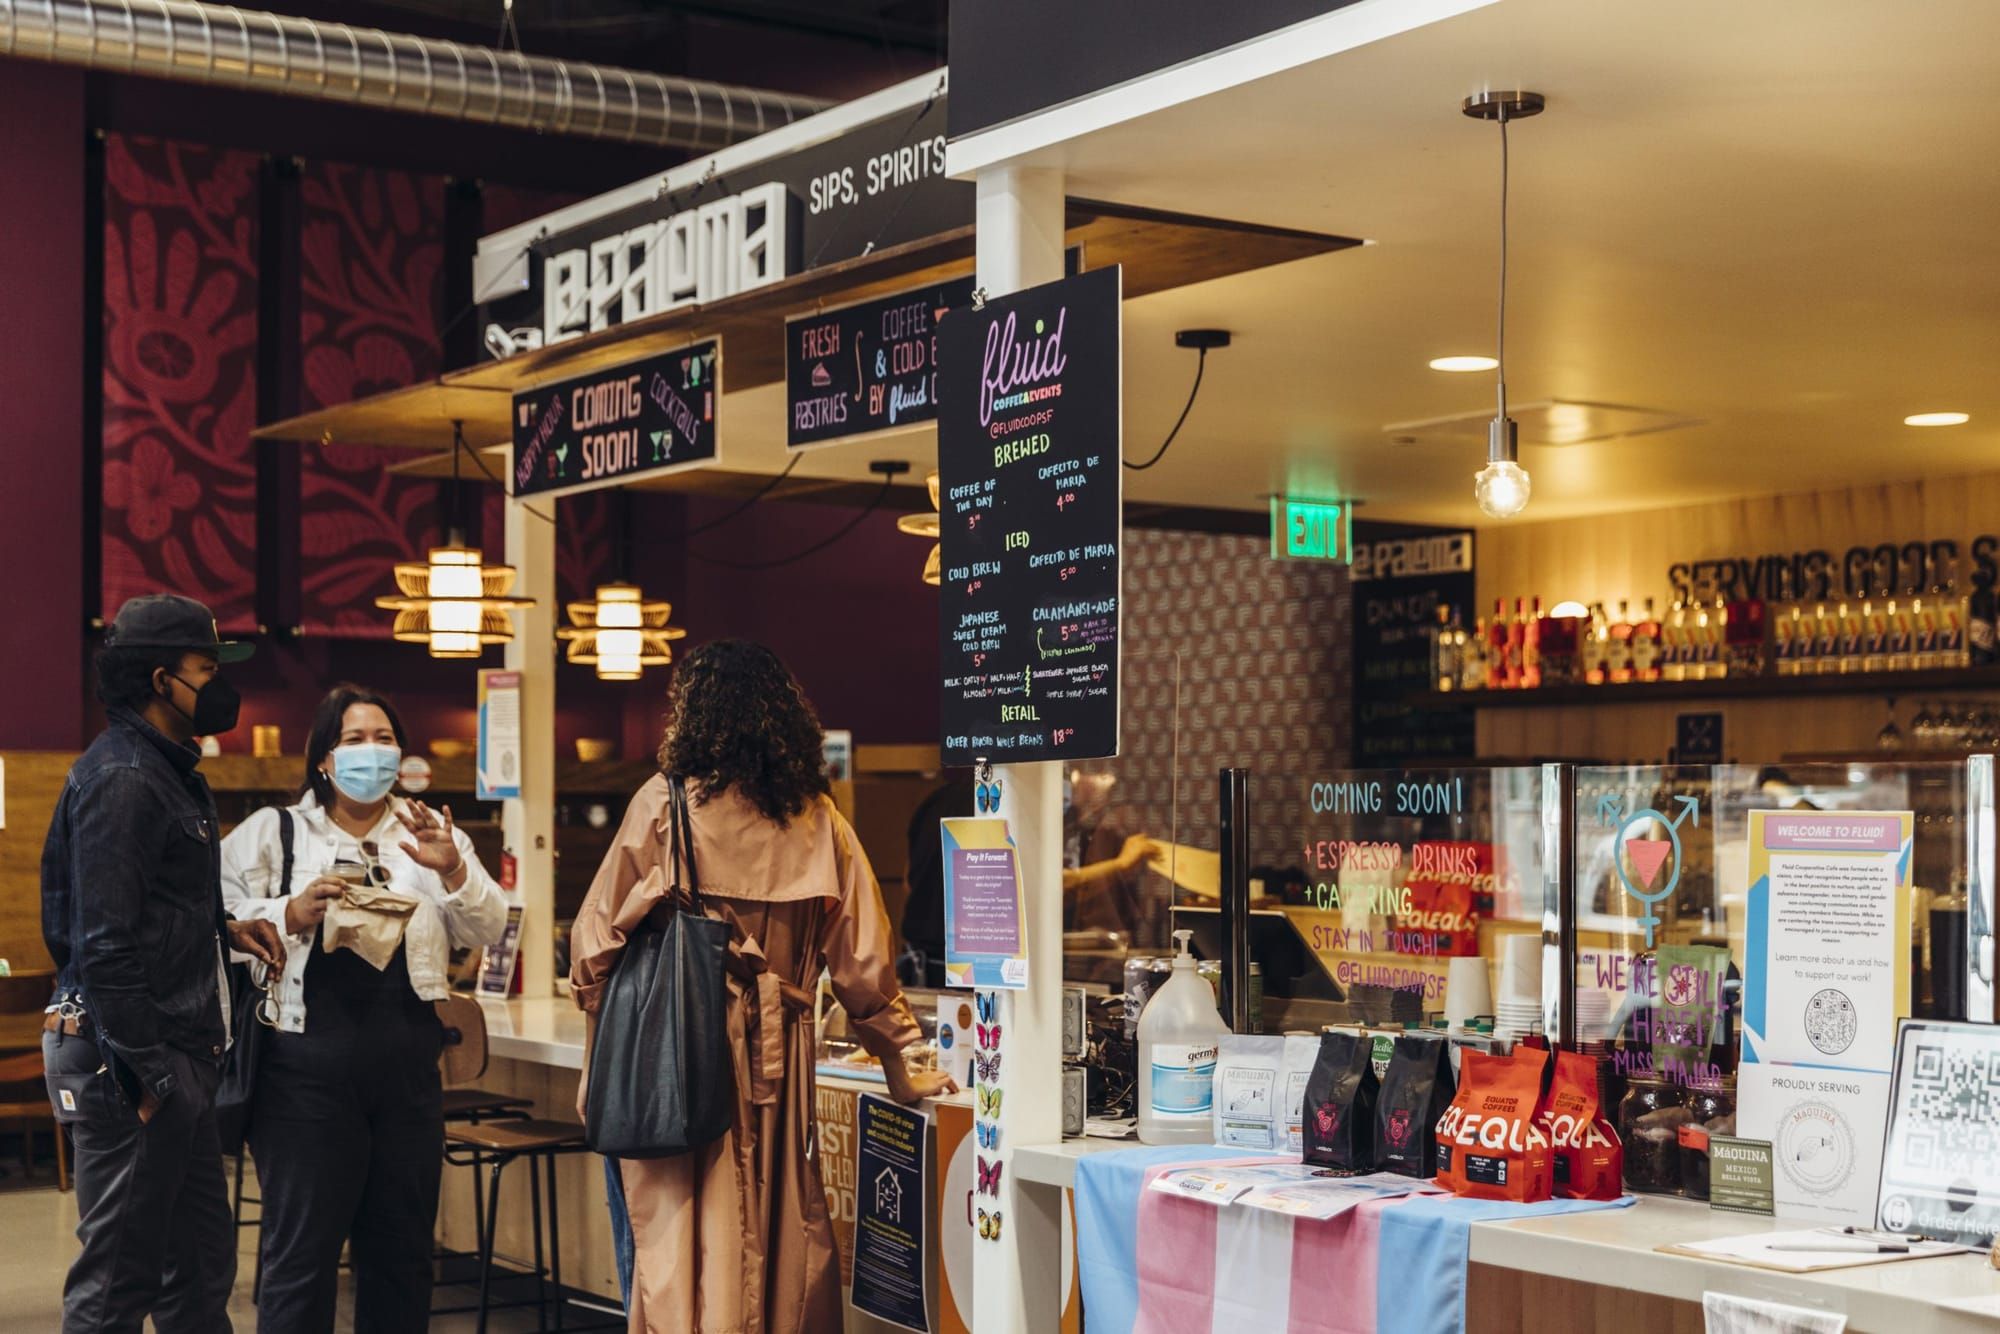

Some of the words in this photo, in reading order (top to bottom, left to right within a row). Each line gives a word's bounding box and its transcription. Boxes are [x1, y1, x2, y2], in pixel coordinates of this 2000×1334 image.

[809, 167, 859, 216] SIPS,
[866, 135, 947, 196] SPIRITS
[882, 302, 927, 341] COFFEE
[802, 323, 840, 360] FRESH
[875, 349, 887, 378] &
[893, 340, 925, 375] COLD
[980, 306, 1067, 428] fluid
[572, 375, 642, 432] COMING
[795, 392, 848, 431] PASTRIES
[869, 384, 885, 416] BY
[889, 376, 927, 425] fluid
[990, 409, 1054, 439] @FLUIDCOOPSF
[581, 428, 638, 479] SOON!
[994, 434, 1050, 468] BREWED
[1039, 460, 1079, 480] CAFECITO
[1087, 456, 1099, 468] DE
[950, 482, 980, 500] COFFEE
[984, 479, 996, 491] OF
[1056, 474, 1086, 490] MARIA
[956, 501, 971, 513] THE
[976, 495, 993, 508] DAY
[1006, 531, 1030, 551] ICED
[1286, 502, 1340, 558] EXIT
[1030, 551, 1066, 568] CAFECITO
[1069, 548, 1080, 560] DE
[1084, 544, 1115, 559] MARIA
[948, 565, 969, 581] COLD
[973, 561, 1001, 577] BREW
[960, 611, 999, 628] JAPANESE
[953, 629, 976, 641] SWEET
[981, 624, 1006, 638] CREAM
[962, 641, 978, 652] COLD
[982, 640, 1000, 651] BREW
[1002, 704, 1040, 722] RETAIL
[946, 735, 968, 748] QUEER
[1018, 734, 1043, 746] BEANS
[1311, 782, 1381, 814] COMING
[1397, 777, 1462, 824] SOON!
[1778, 826, 1832, 837] WELCOME
[1835, 827, 1849, 837] TO
[1852, 827, 1884, 838] FLUID!
[1316, 840, 1402, 870] ESPRESSO
[1412, 843, 1478, 878] DRINKS
[1316, 883, 1412, 916] CARING
[1313, 925, 1351, 950] STAY
[1359, 929, 1374, 953] IN
[1775, 952, 1798, 961] Learn
[1822, 955, 1844, 964] about
[1873, 959, 1889, 967] how
[1337, 961, 1448, 999] @FLUIDCOOPSF
[1670, 964, 1729, 1010] STILL
[1805, 971, 1834, 981] support
[1851, 972, 1871, 981] work!
[1772, 1078, 1815, 1091] PROUDLY
[1818, 1081, 1861, 1095] SERVING
[1482, 1103, 1516, 1113] COFFEES
[1485, 1095, 1519, 1105] EQUATOR
[1726, 1164, 1758, 1174] MEXICO
[1743, 1176, 1762, 1184] VISTA
[1918, 1211, 1958, 1230] Order
[1965, 1218, 2000, 1235] Here
